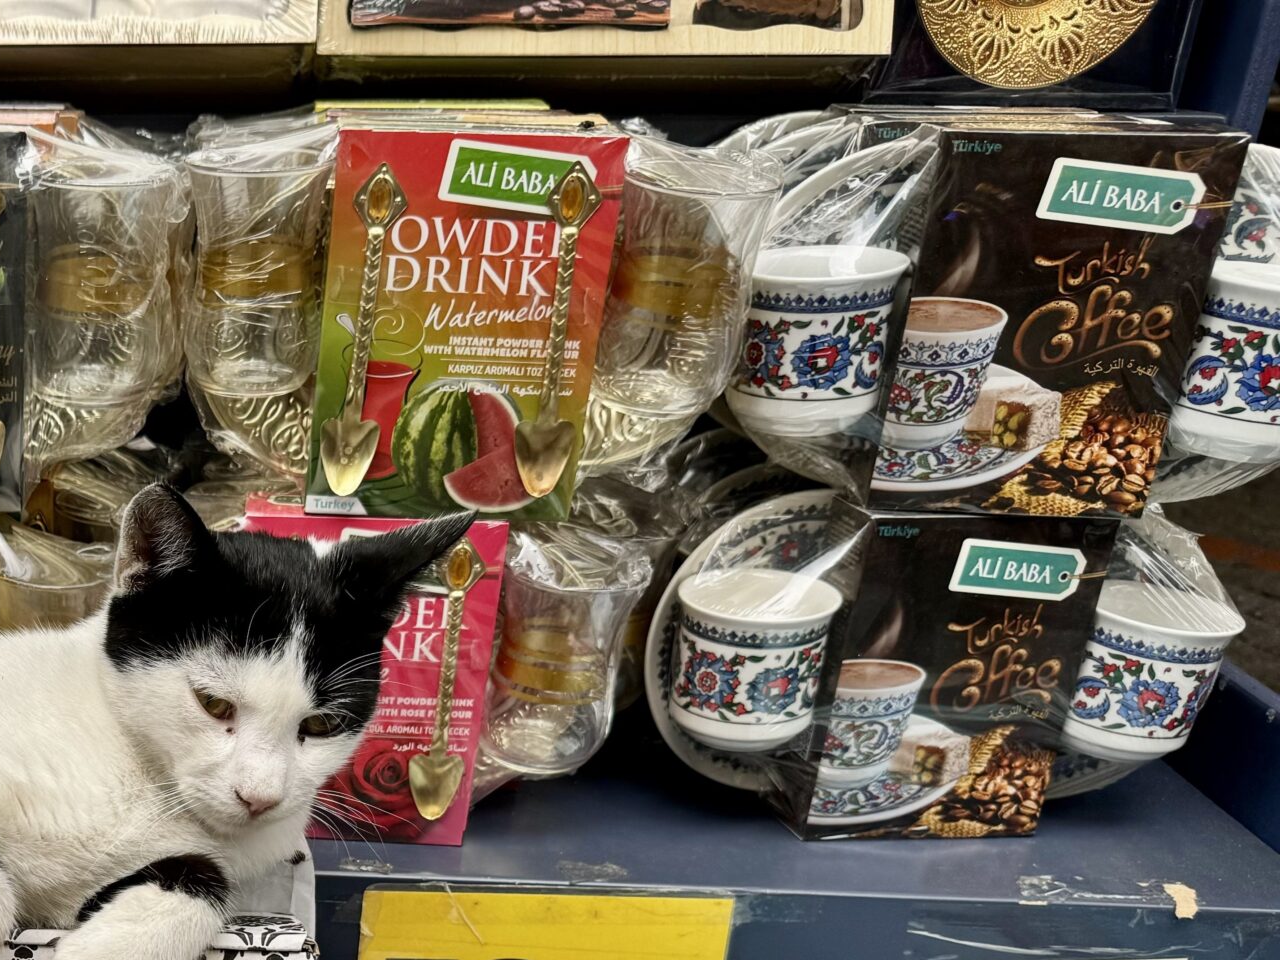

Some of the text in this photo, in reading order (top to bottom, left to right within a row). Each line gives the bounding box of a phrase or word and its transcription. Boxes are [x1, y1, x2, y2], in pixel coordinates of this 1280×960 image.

[877, 127, 911, 140] Türki
[951, 139, 1003, 155] Türkiye
[500, 165, 557, 196] BABA
[1104, 185, 1161, 215] BABA
[391, 215, 583, 260] OWDE
[384, 254, 553, 298] DRINK
[1034, 237, 1151, 295] Turkish
[1013, 284, 1175, 369] Coffee
[423, 345, 580, 360] WITH WATERMELON FLAUR
[448, 336, 495, 347] INSTANT
[496, 338, 543, 349] POWDER
[447, 364, 483, 375] KARPUZ
[484, 365, 524, 376] AROMALI
[526, 367, 543, 377] TOZ
[313, 498, 355, 512] Turkey
[878, 525, 921, 539] Türkiye
[1004, 559, 1051, 585] BABA
[947, 603, 1044, 654] Turkish
[930, 644, 1061, 716] Coffee
[400, 708, 425, 718] ROSE
[427, 710, 473, 719] FOUR
[386, 725, 423, 735] AROMALI
